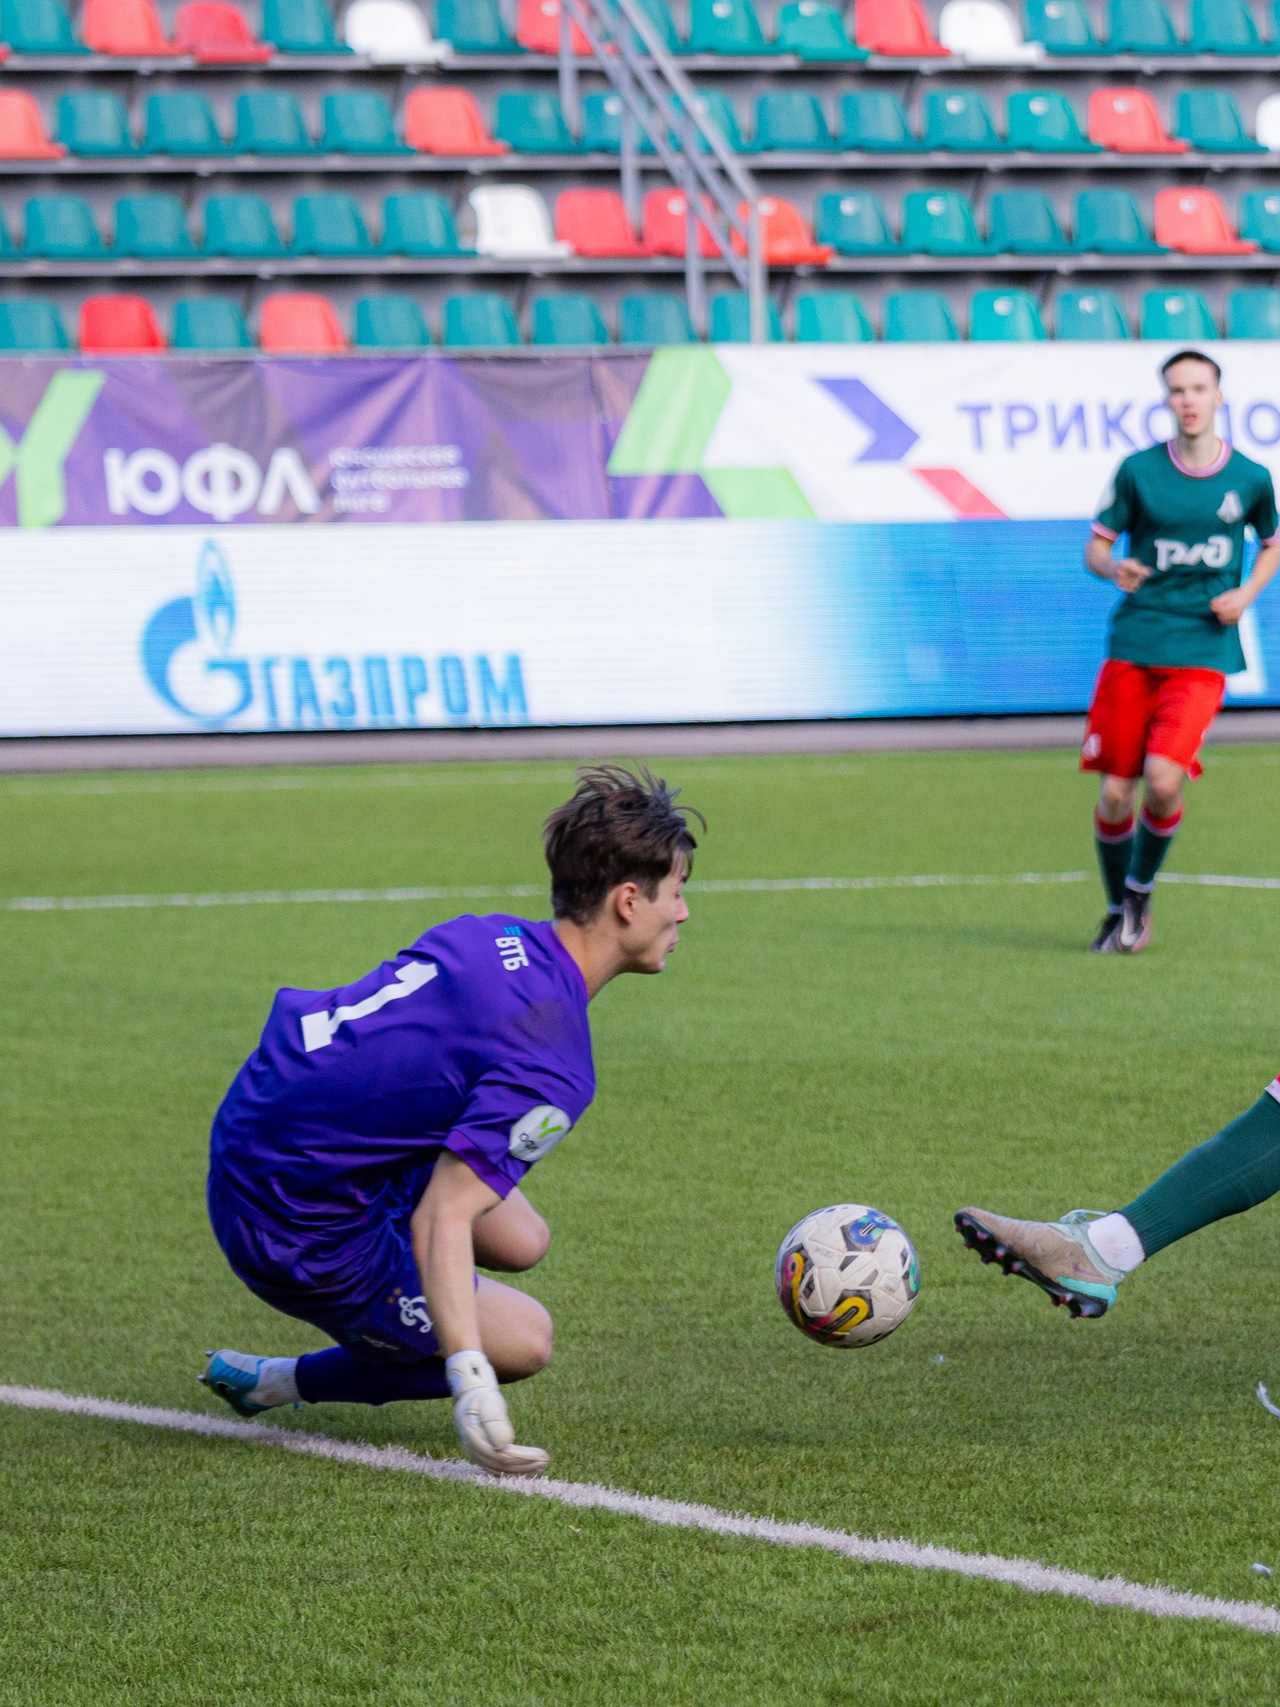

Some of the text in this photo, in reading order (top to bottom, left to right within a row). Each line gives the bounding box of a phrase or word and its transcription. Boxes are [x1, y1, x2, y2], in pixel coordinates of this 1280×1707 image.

[103, 442, 320, 523] ЮФЛ
[262, 652, 530, 727] ГАЗПРОМ
[494, 936, 529, 971] ВТБ
[301, 961, 439, 1053] 1
